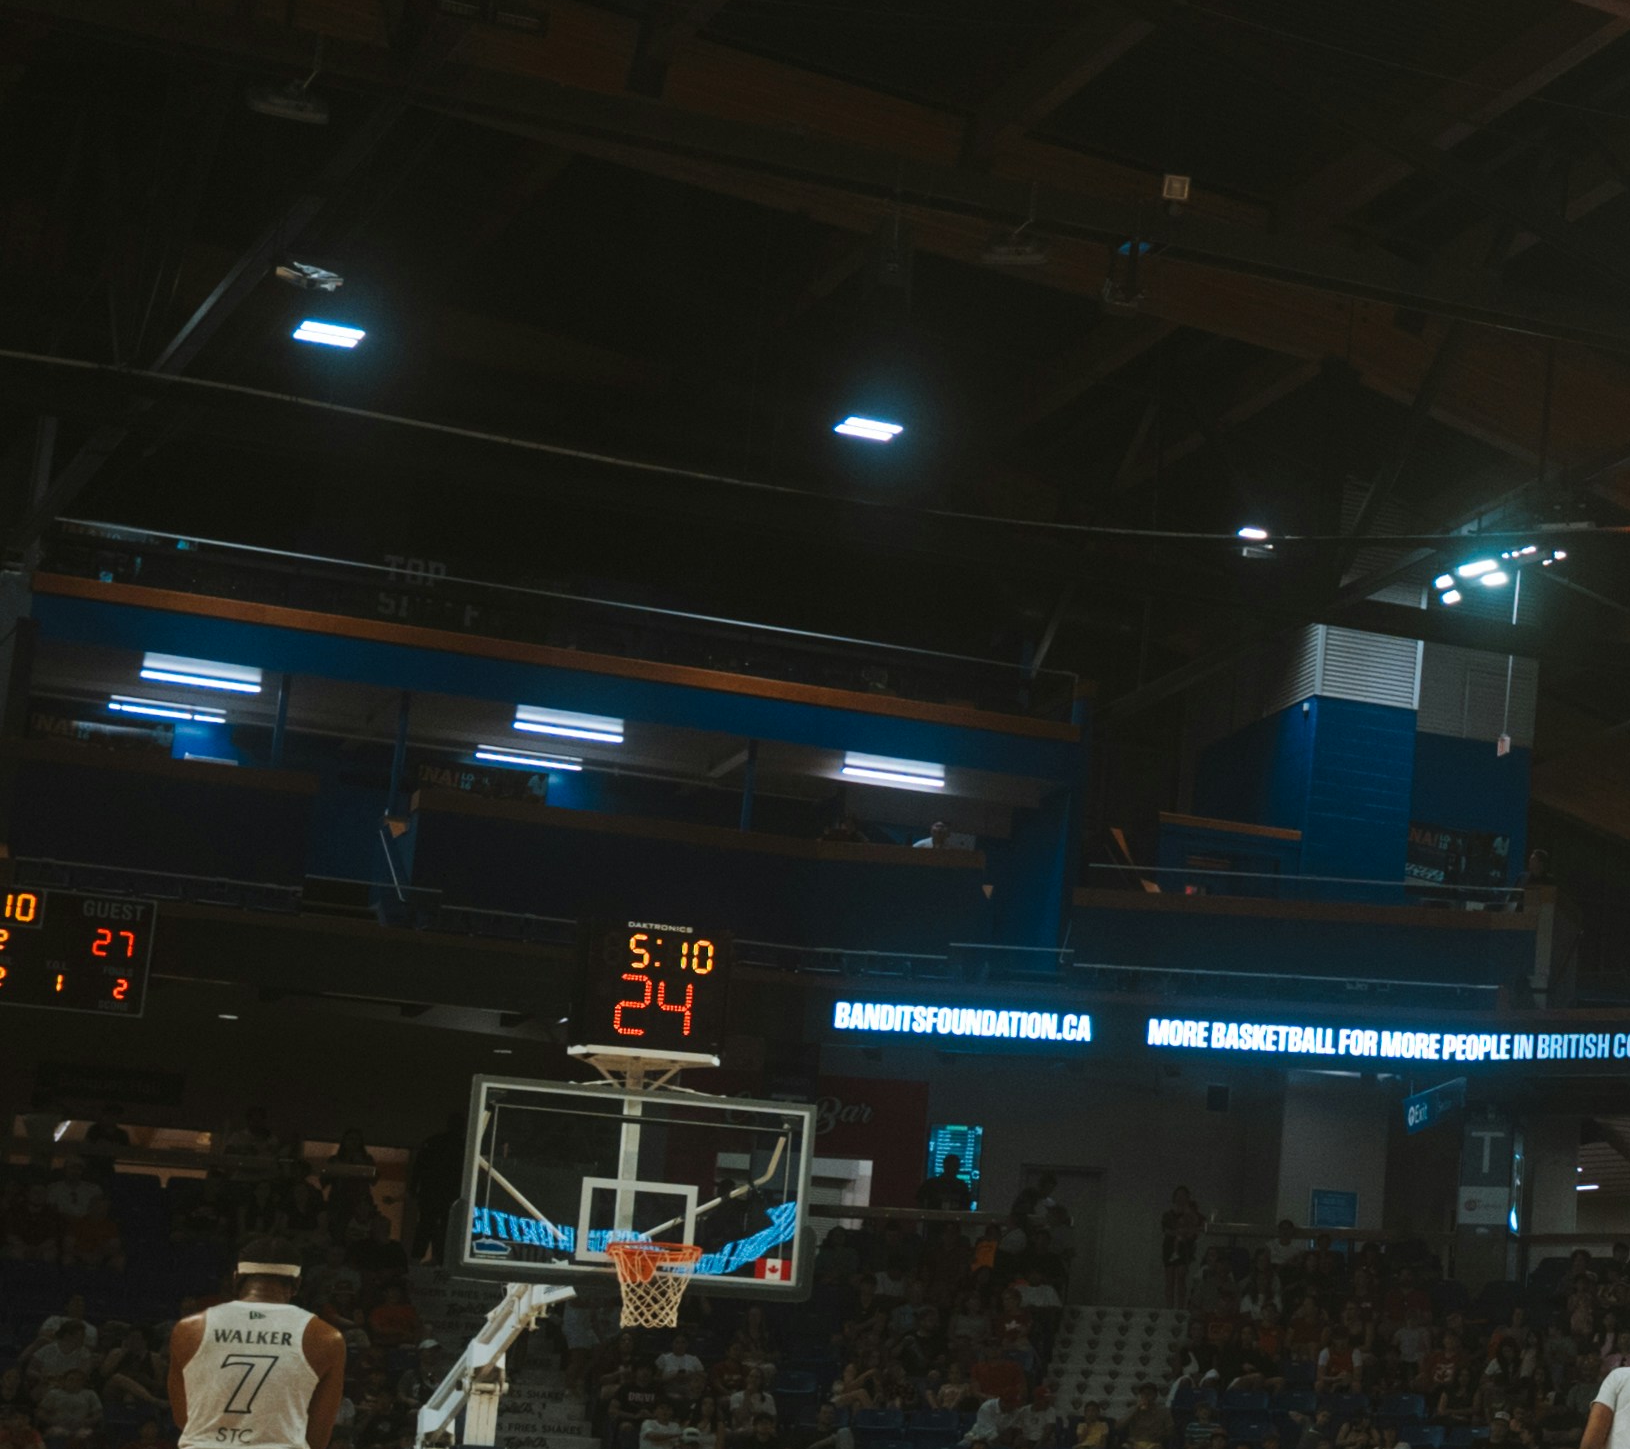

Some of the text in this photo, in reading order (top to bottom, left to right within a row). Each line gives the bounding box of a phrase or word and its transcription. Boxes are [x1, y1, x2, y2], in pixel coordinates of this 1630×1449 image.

[84, 900, 145, 921] GUEST
[628, 921, 694, 934] DAKTRONICS
[92, 928, 135, 957] 27
[630, 933, 714, 975] 5:10
[113, 979, 129, 999] 2
[613, 973, 694, 1036] 24
[834, 1002, 1092, 1042] BANDITSFOUNDATION.CA
[1148, 1019, 1208, 1048] MORE
[1211, 1022, 1336, 1055] BASKETBALL
[1338, 1028, 1379, 1057] FOR
[1381, 1031, 1440, 1059] MORE
[1442, 1034, 1510, 1061] PEOPLE
[1513, 1034, 1534, 1059] IN
[1537, 1034, 1610, 1059] BRITISH
[214, 1329, 293, 1347] WALKER
[220, 1354, 279, 1414] 7
[215, 1427, 253, 1443] STC
